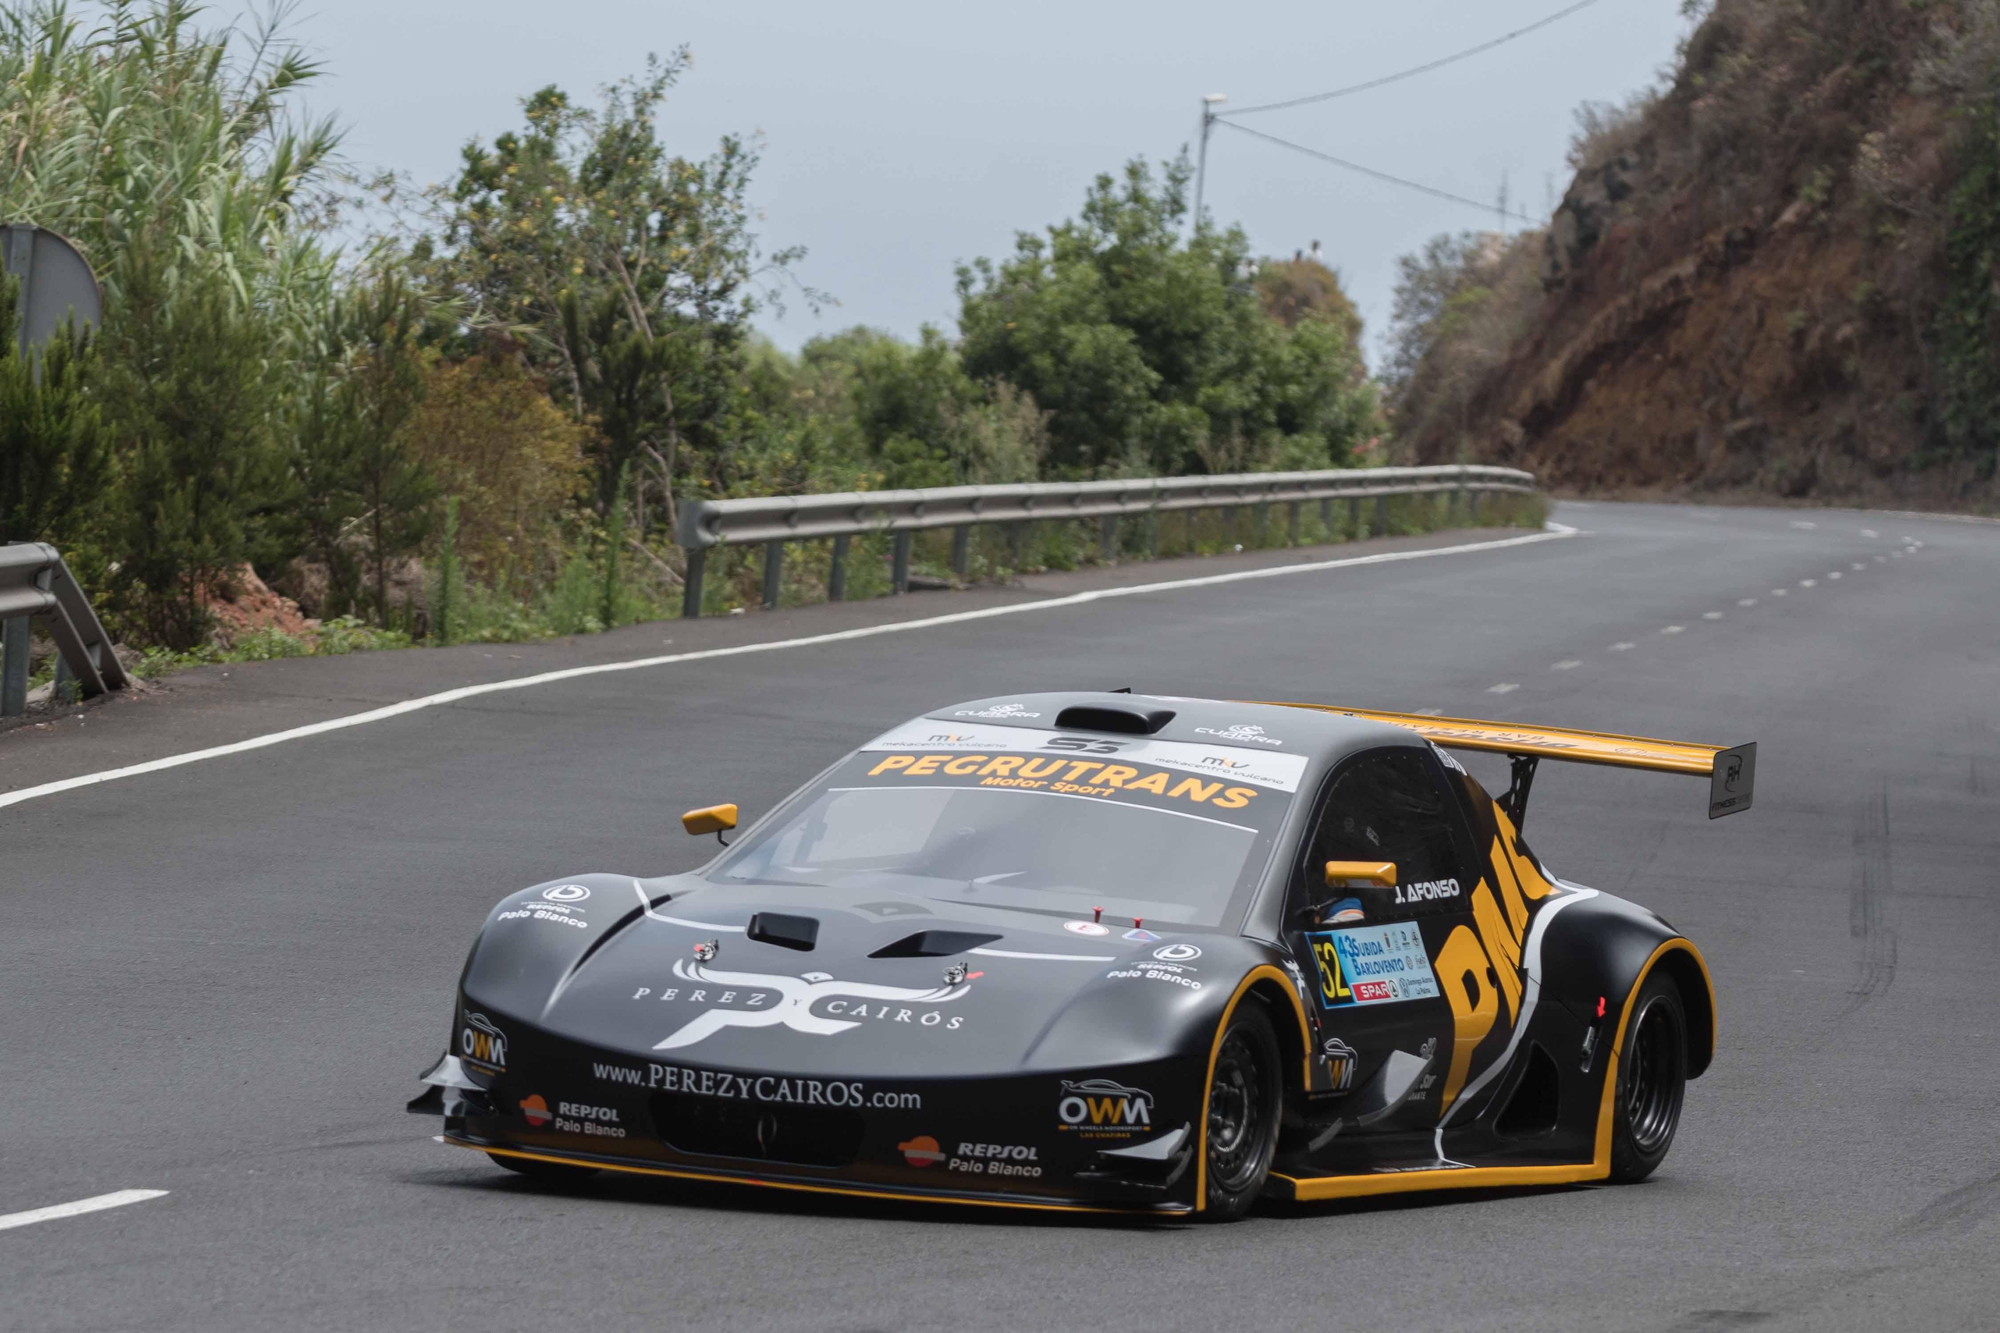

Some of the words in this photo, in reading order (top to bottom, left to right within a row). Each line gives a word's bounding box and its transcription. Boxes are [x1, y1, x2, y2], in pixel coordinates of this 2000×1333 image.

[1155, 756, 1231, 774] mekacentro
[1234, 770, 1284, 785] vulcano
[867, 754, 1259, 809] PEGRUTRANS
[980, 776, 1048, 791] Motor
[1054, 781, 1116, 799] Sport
[1407, 878, 1460, 903] AFONSO
[498, 910, 531, 921] Palo
[533, 910, 588, 928] Blanco
[1137, 963, 1183, 974] REPSOL
[1312, 941, 1352, 999] 52
[1352, 958, 1405, 976] BARLOVENTO
[1107, 969, 1142, 979] Palo
[1146, 969, 1202, 990] Blanco
[1360, 985, 1390, 999] SPAR
[631, 987, 767, 1006] PEREZ
[826, 1000, 965, 1030] CAIRÓS
[462, 1027, 506, 1066] OWM
[559, 1101, 620, 1121] REPSOL
[1059, 1096, 1151, 1125] OWM
[555, 1117, 582, 1132] Palo
[584, 1121, 626, 1138] Blanco
[957, 1142, 1039, 1160] REPSOL
[948, 1158, 984, 1173] Palo
[987, 1161, 1043, 1177] Blanco
